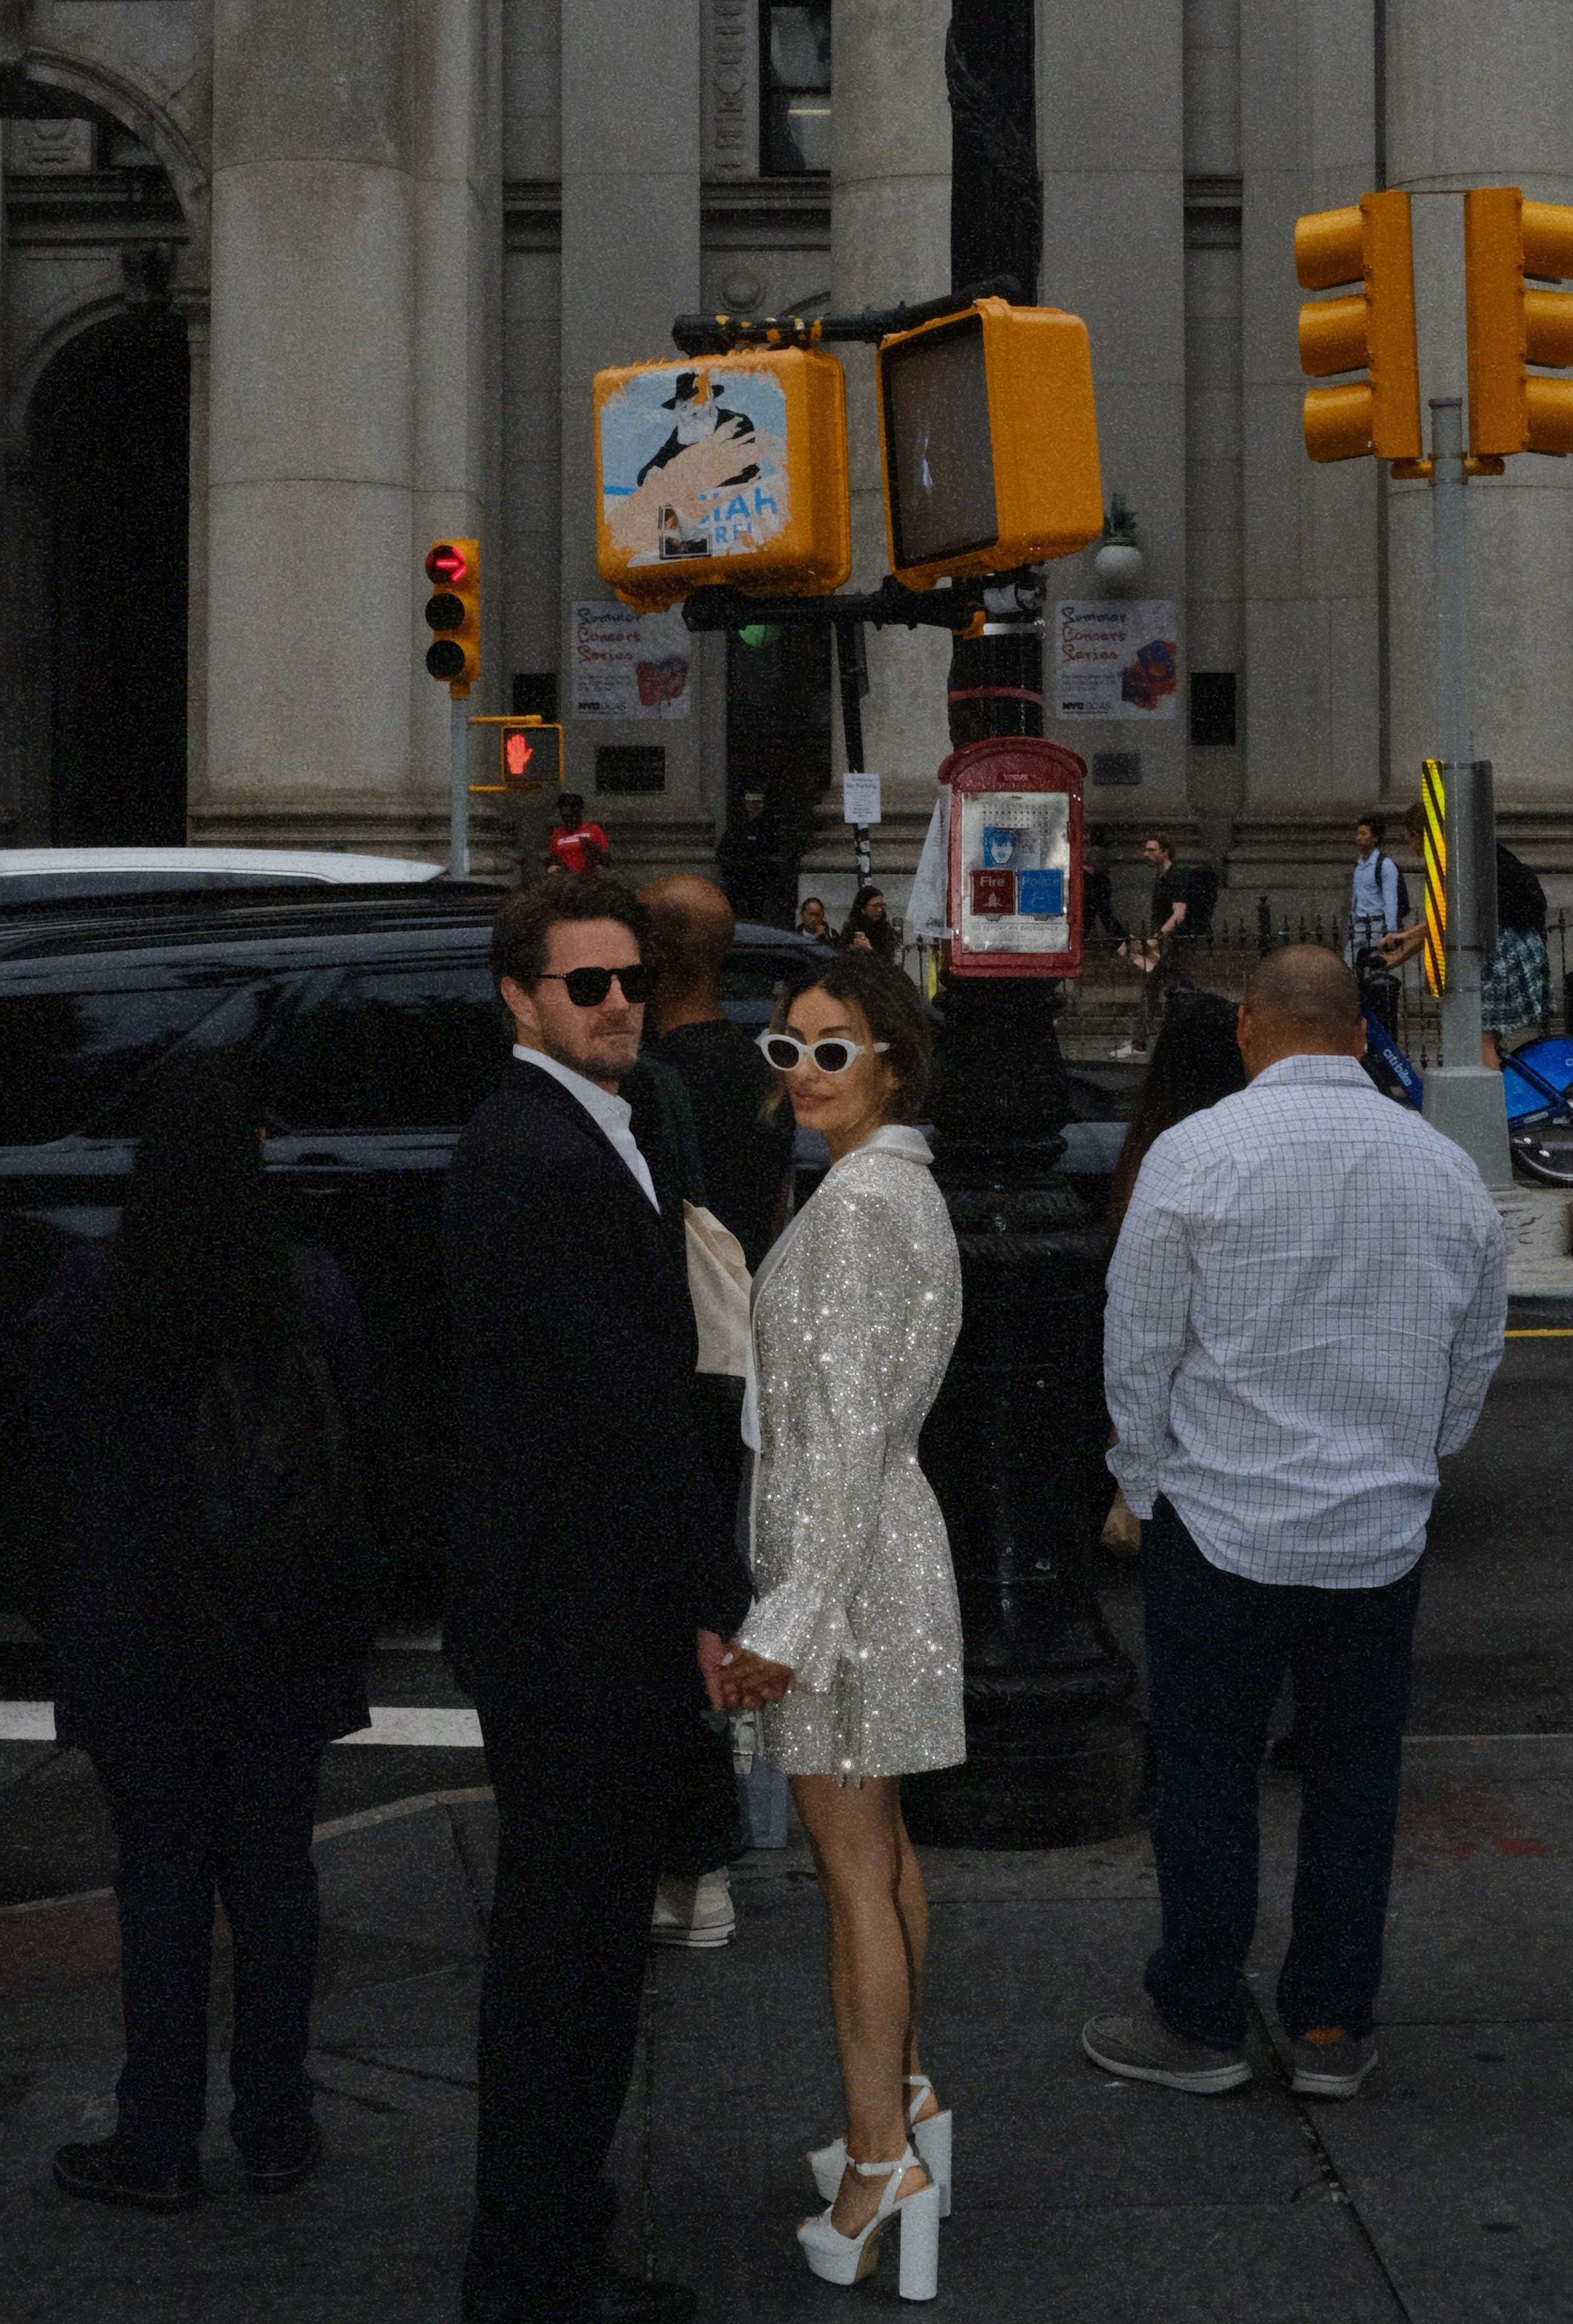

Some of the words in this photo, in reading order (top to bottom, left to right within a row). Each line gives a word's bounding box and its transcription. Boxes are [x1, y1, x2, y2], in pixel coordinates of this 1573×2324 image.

[1061, 607, 1127, 625] Summer
[578, 627, 641, 644] Concert
[1063, 626, 1126, 642] Concert
[577, 645, 633, 663] Series
[1061, 644, 1118, 662] Series
[980, 876, 1005, 887] Fire
